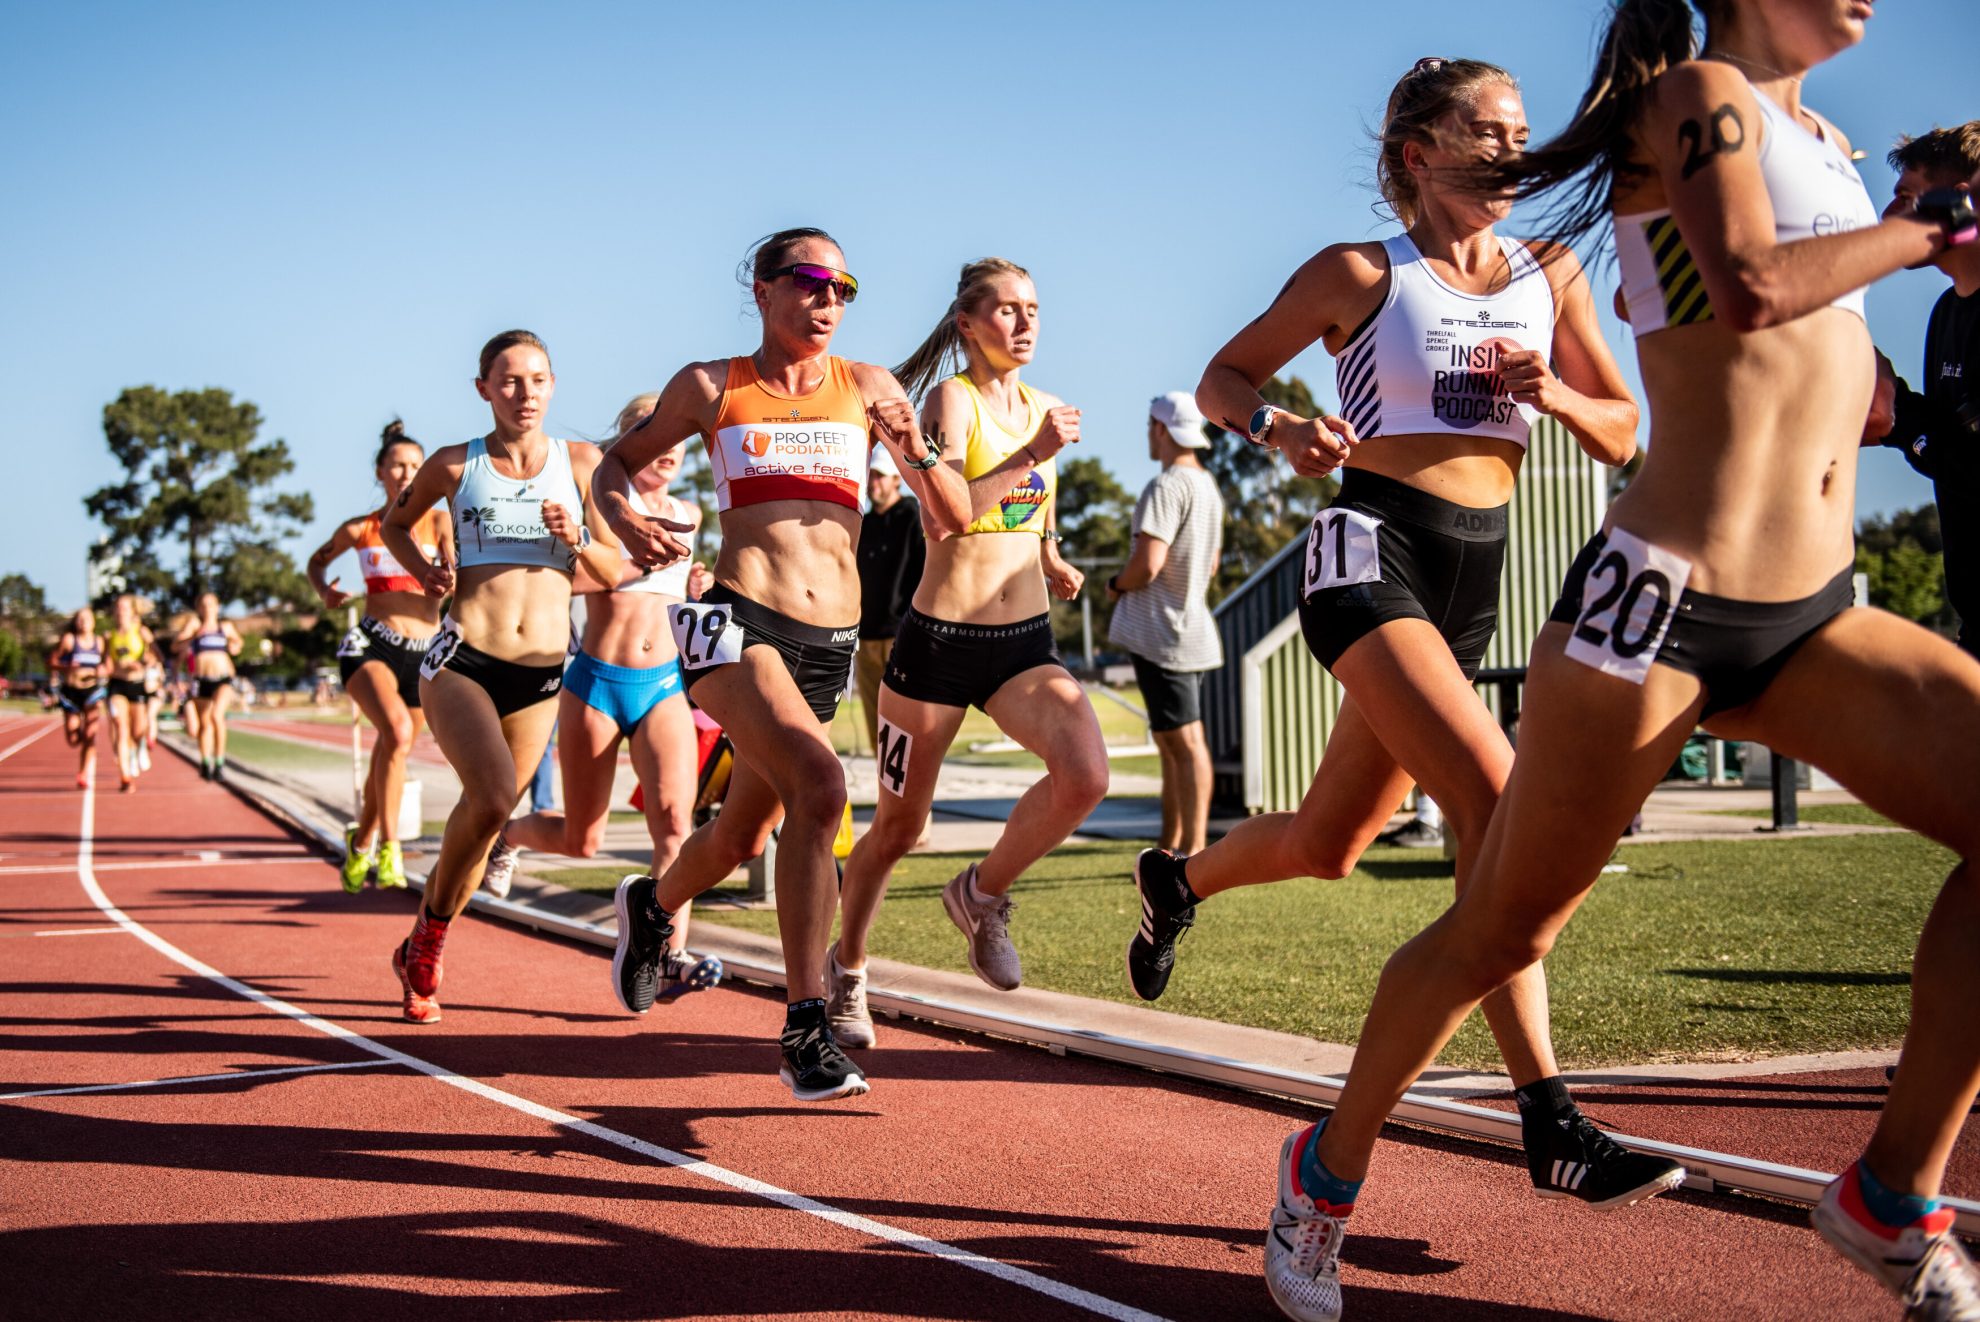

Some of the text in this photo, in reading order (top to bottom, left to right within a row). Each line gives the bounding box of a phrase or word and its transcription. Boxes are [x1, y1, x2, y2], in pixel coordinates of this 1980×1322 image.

[1678, 103, 1745, 181] 20
[1441, 318, 1527, 329] STEIGEN
[1451, 344, 1500, 369] INSI
[1434, 370, 1509, 398] RUNNIN
[1434, 396, 1516, 425] PODCAST
[775, 432, 848, 445] PRO FEET
[744, 462, 850, 477] active feet
[496, 536, 540, 545] SKINCARE
[1308, 513, 1348, 587] 31
[1574, 551, 1671, 659] 20
[371, 620, 404, 646] PRO
[677, 608, 727, 664] 29
[831, 629, 857, 642] NIKE
[941, 625, 991, 638] ARMOUR
[1007, 619, 1045, 637] ARMOUR
[879, 723, 908, 792] 14
